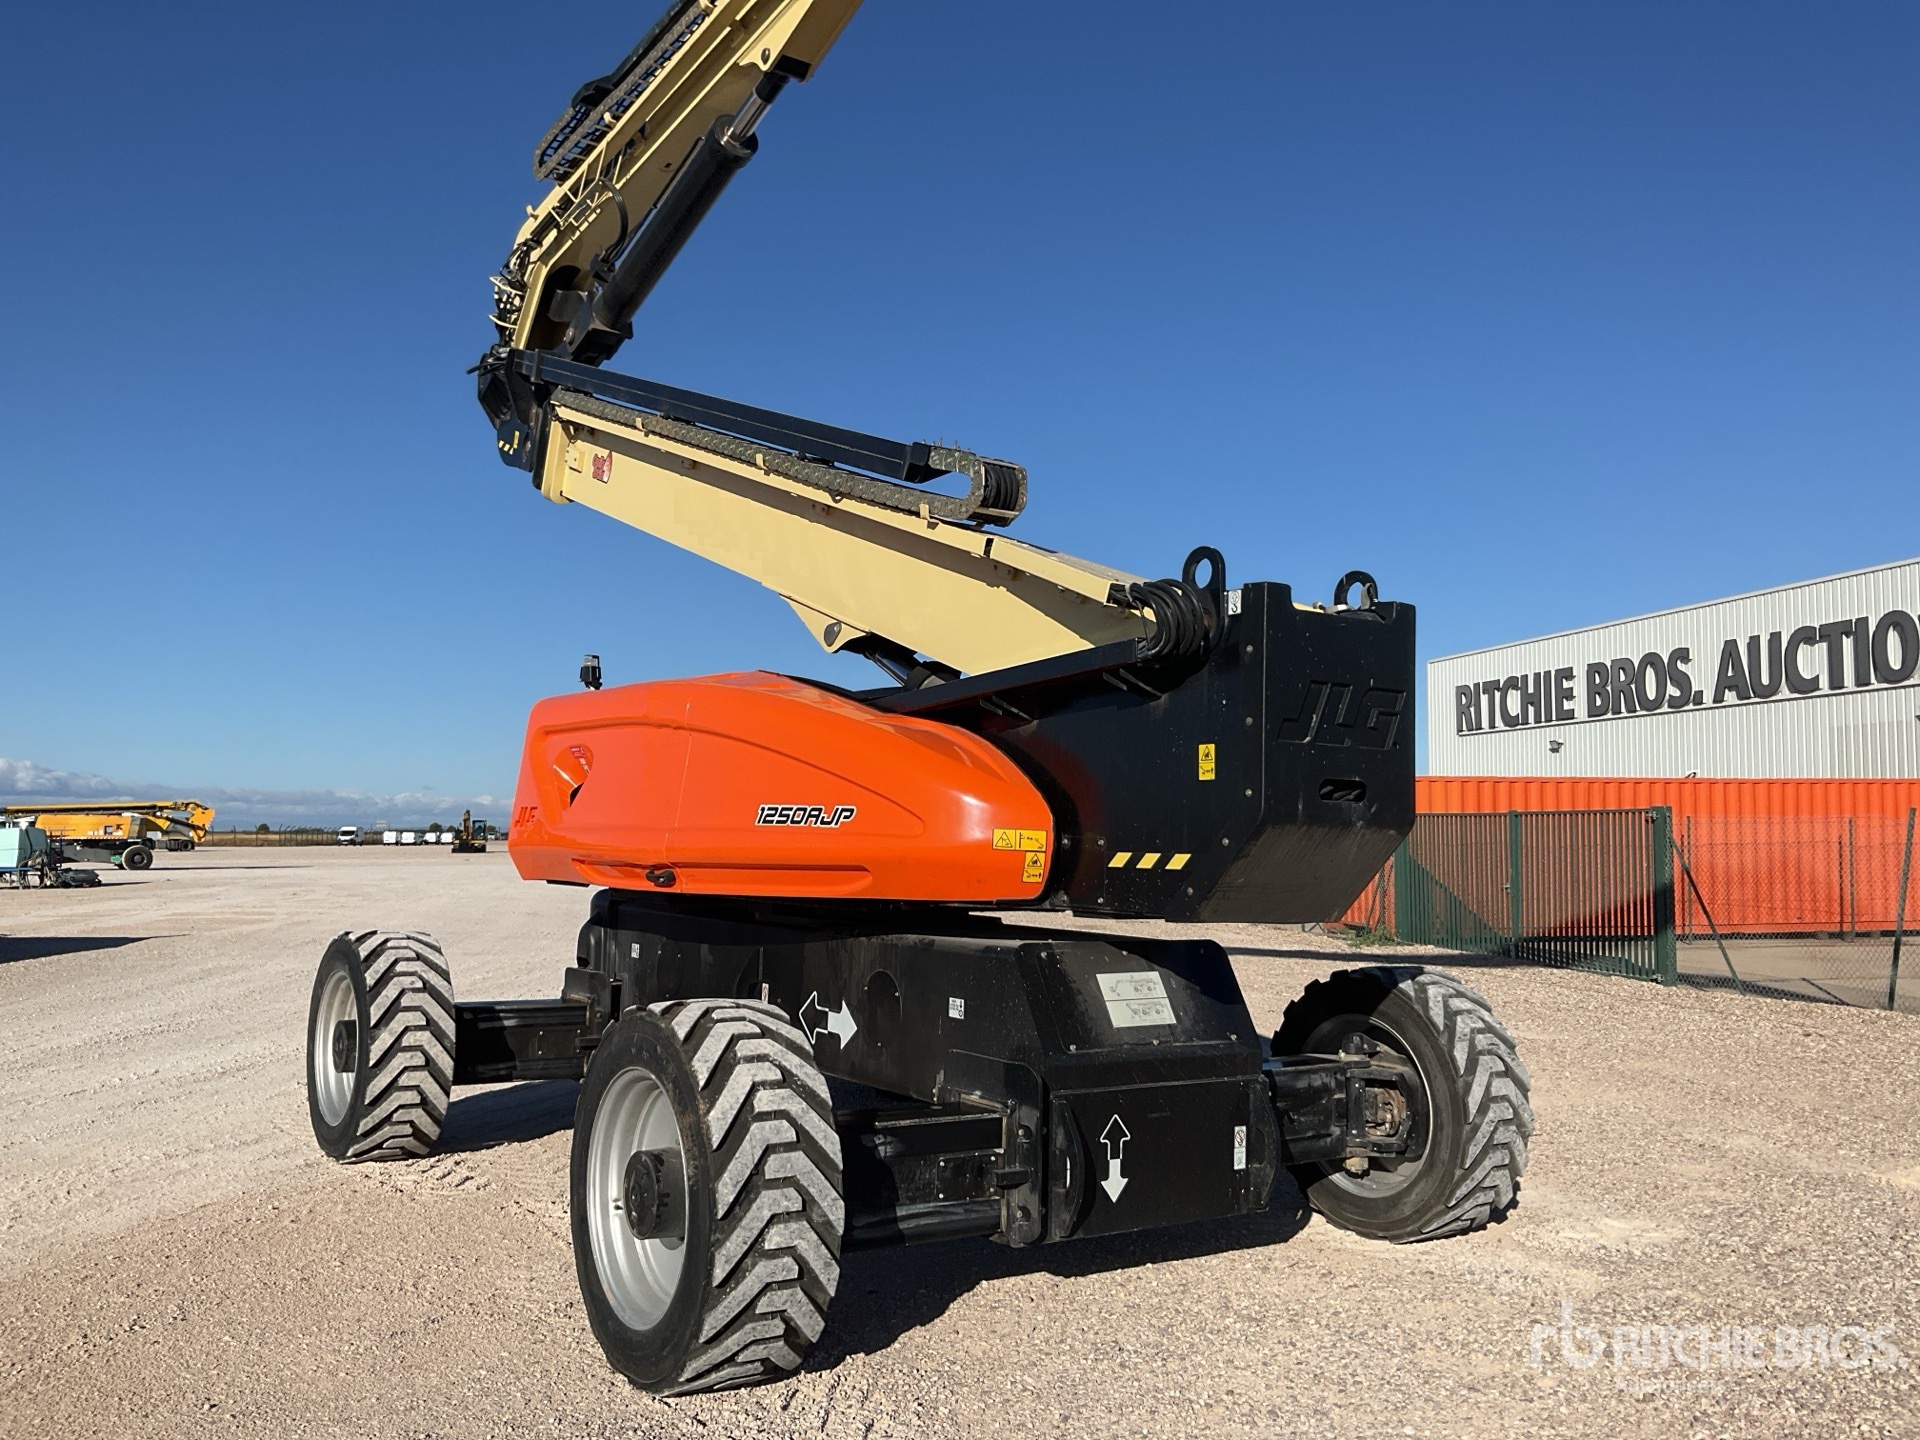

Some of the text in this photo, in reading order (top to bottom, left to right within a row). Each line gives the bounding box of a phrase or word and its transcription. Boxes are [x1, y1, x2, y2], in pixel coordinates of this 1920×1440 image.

[1456, 609, 1920, 732] RITCHIE BROS. AUCTIO
[1277, 679, 1407, 751] JLG
[755, 804, 856, 828] 1250AJP
